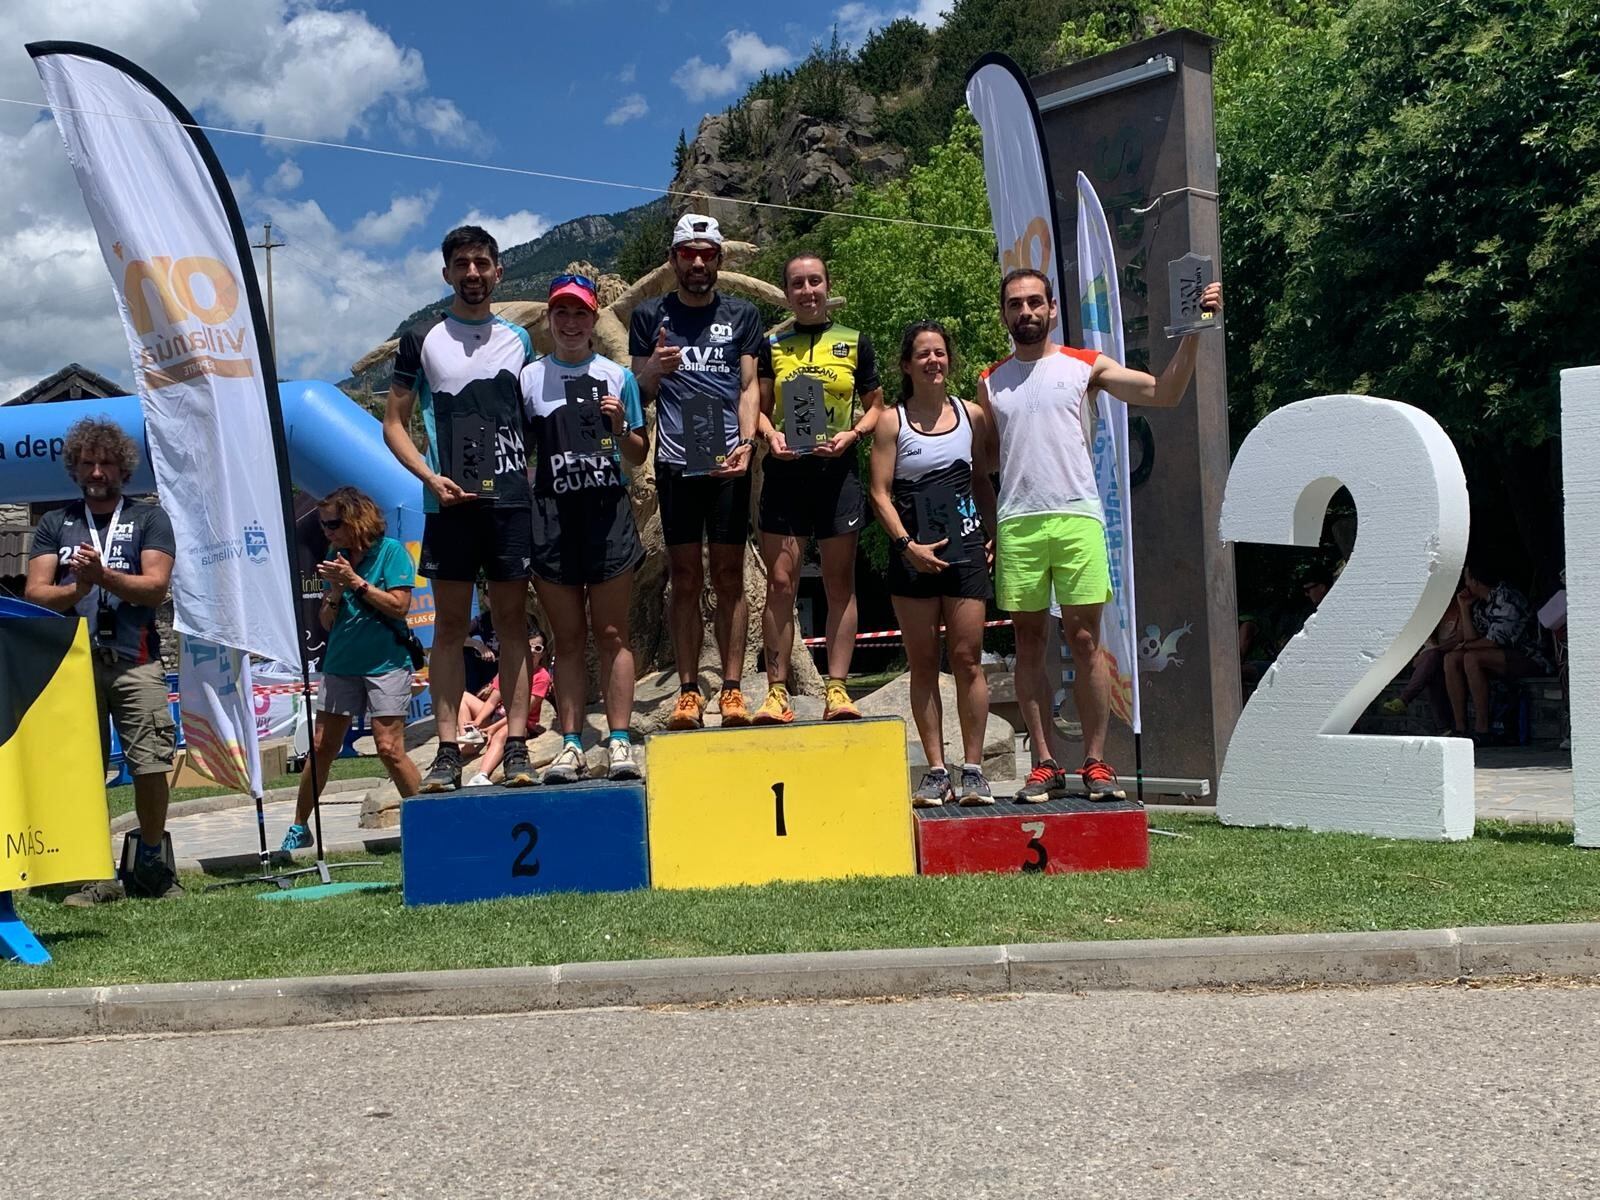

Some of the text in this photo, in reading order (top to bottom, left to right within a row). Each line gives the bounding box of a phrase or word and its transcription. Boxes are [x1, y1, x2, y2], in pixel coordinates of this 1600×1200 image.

[678, 361, 730, 373] collarada
[679, 346, 713, 366] KV
[15, 434, 65, 461] dep
[553, 470, 620, 494] GUARA
[771, 782, 787, 837] 1
[7, 825, 60, 858] MÁS...
[511, 822, 540, 878] 2
[1021, 821, 1048, 874] 3
